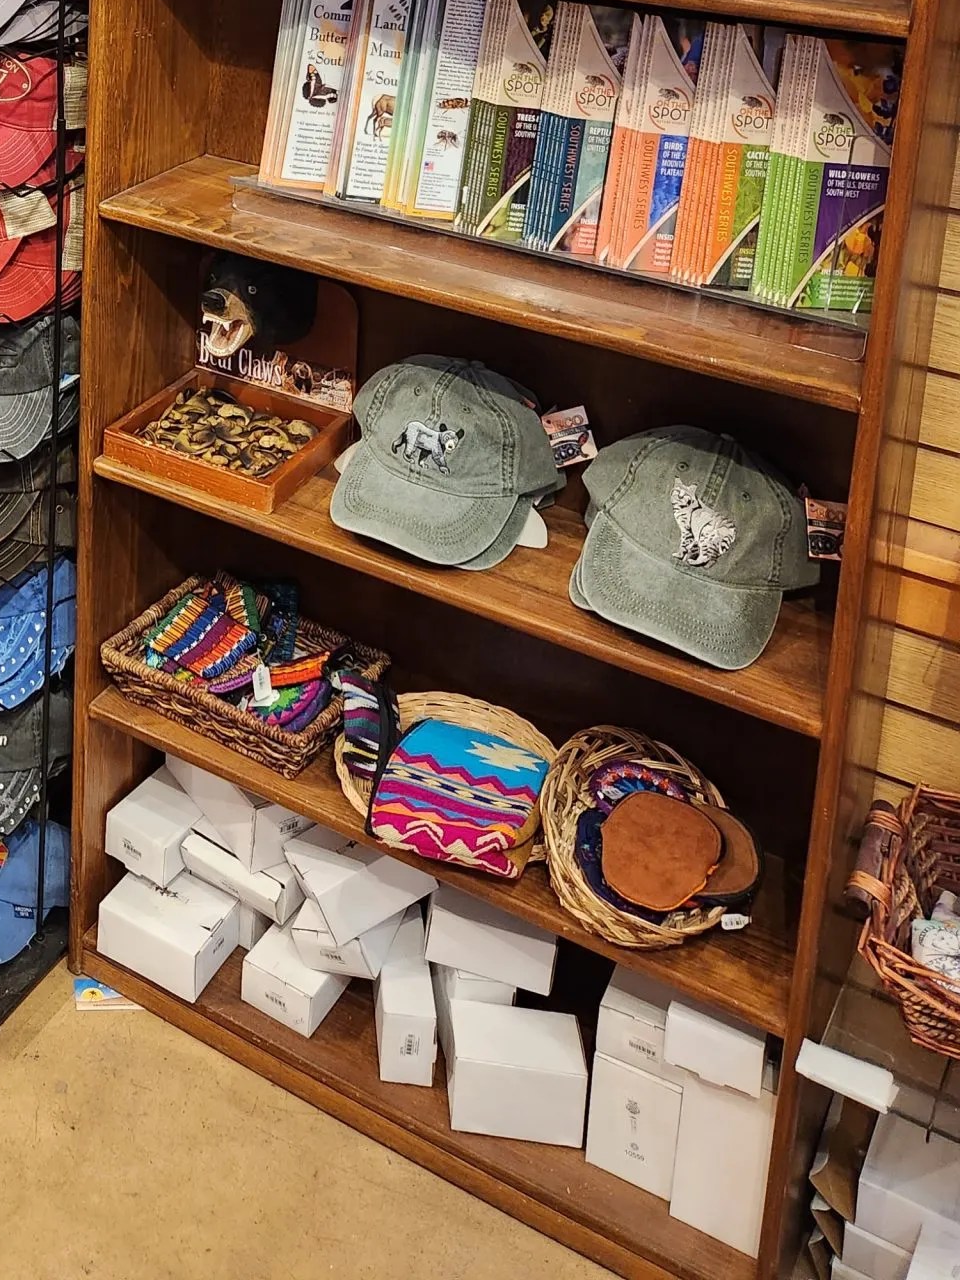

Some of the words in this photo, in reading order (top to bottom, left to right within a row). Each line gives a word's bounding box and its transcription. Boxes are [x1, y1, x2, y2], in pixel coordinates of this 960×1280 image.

[375, 14, 406, 32] Land
[522, 74, 538, 82] THE
[507, 79, 542, 95] SPOT
[597, 86, 612, 95] THE
[579, 92, 615, 107] SPOT
[671, 100, 687, 108] THE
[517, 113, 535, 122] TREES
[652, 106, 690, 121] SPOT
[740, 107, 752, 115] ON
[755, 108, 769, 116] THE
[523, 122, 533, 130] THE
[735, 114, 773, 130] SPOT
[836, 126, 851, 134] THE
[490, 111, 508, 166] SOUTHWEST
[664, 141, 683, 150] BIRDS
[817, 132, 855, 148] SPOT
[565, 123, 581, 178] SOUTHWEST
[662, 150, 671, 158] OF
[671, 151, 681, 159] THE
[747, 151, 763, 162] CACTI
[639, 139, 655, 193] SOUTHWEST
[745, 161, 753, 169] OF
[754, 161, 763, 170] THE
[487, 167, 501, 198] SERIES
[722, 149, 737, 204] SOUTHWEST
[835, 180, 844, 188] THE
[858, 181, 878, 190] DESERT
[559, 181, 572, 213] SERIES
[804, 168, 819, 226] SOUTHWEST
[634, 197, 648, 230] SERIES
[716, 209, 730, 243] SERIES
[797, 230, 811, 264] SERIES
[239, 347, 283, 387] Claws
